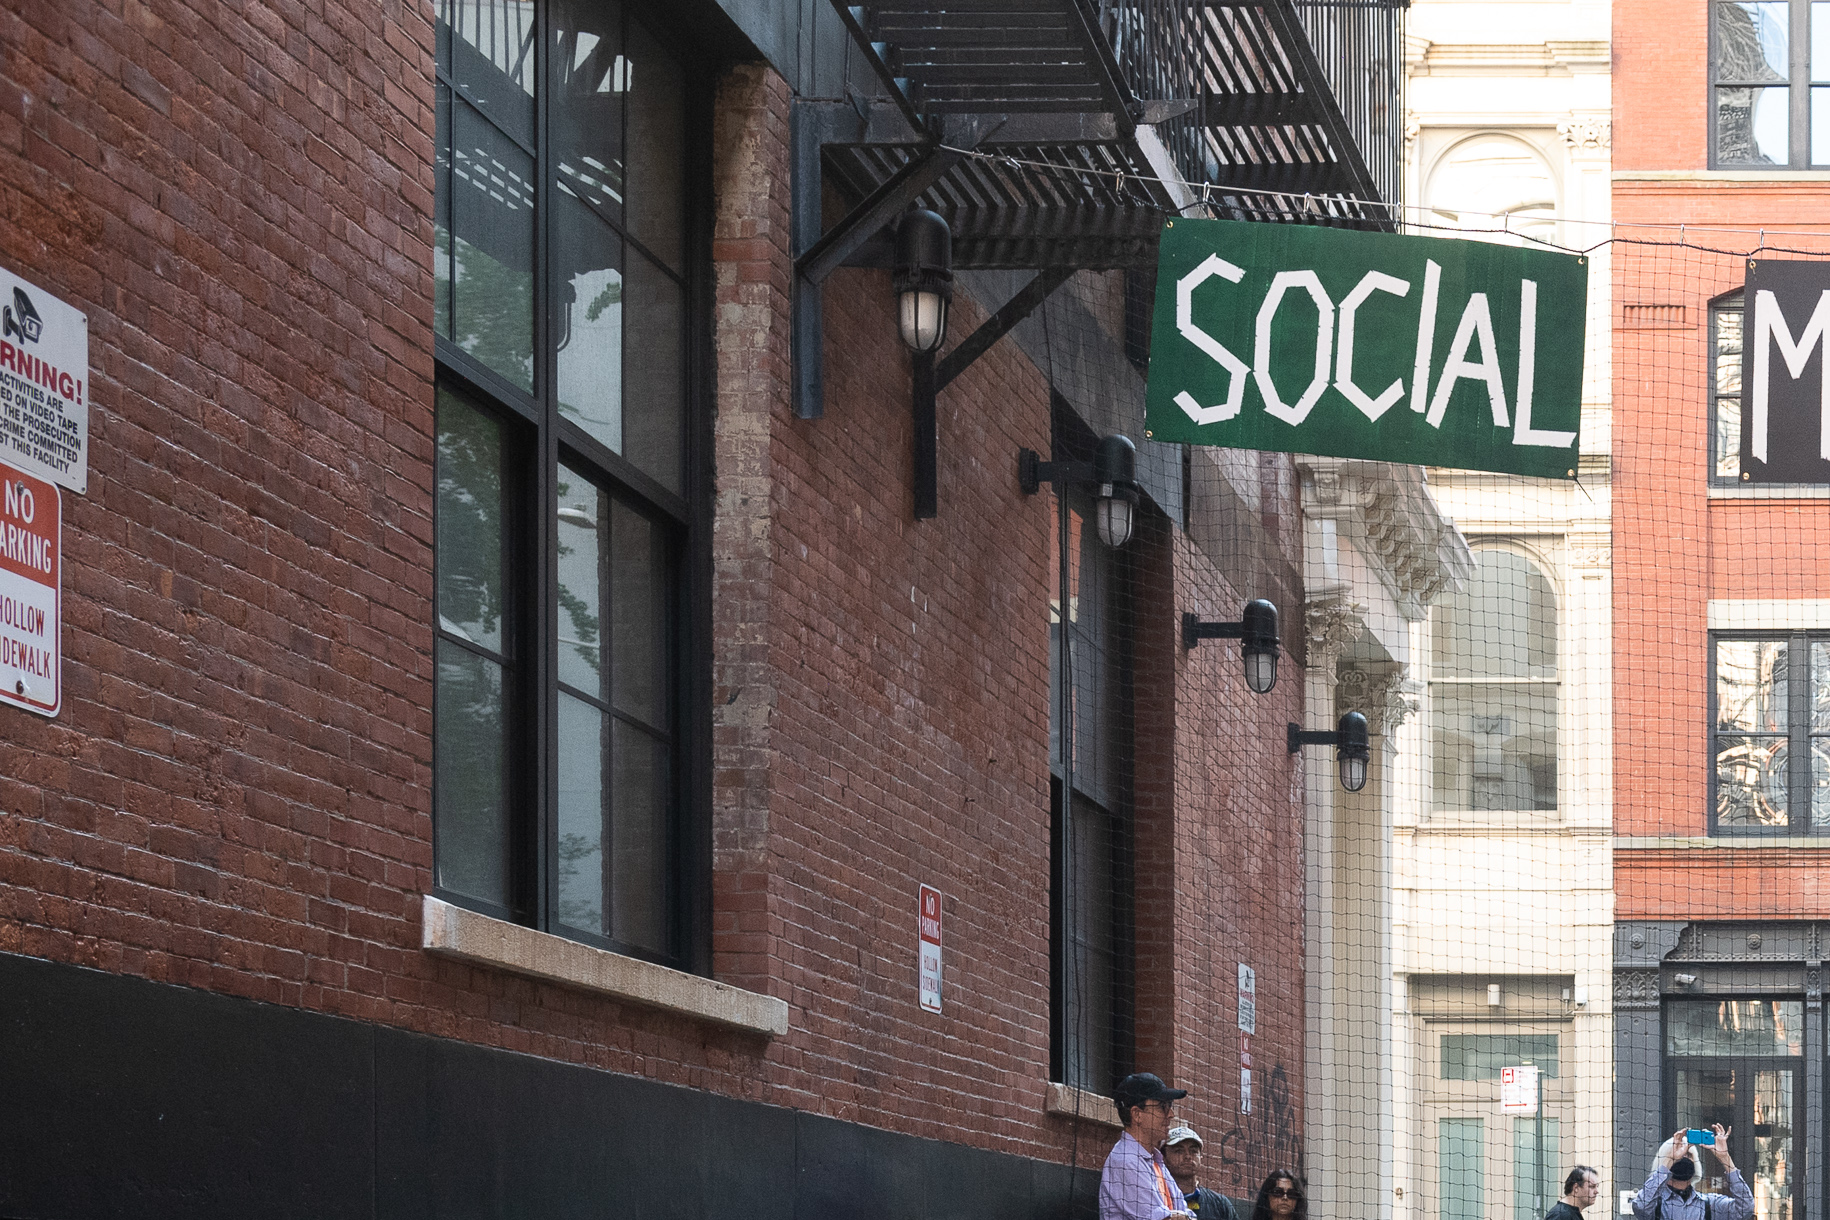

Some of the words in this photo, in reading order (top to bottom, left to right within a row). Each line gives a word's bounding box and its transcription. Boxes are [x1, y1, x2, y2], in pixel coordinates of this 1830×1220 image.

[0, 339, 82, 405] RNING!
[1173, 253, 1577, 449] SOCIAL
[0, 371, 44, 403] ACTIVITIES
[46, 395, 63, 413] ARE
[0, 387, 12, 401] ED
[15, 394, 27, 409] ON
[30, 400, 55, 423] VIDEO
[57, 413, 78, 435] TAPE
[3, 403, 20, 421] THE
[23, 412, 81, 451] PROSECUTION
[28, 430, 78, 463] COMMITTED
[12, 437, 31, 457] THIS
[33, 448, 70, 474] FACILITY
[5, 479, 35, 524] NO
[0, 520, 52, 574] ARKING
[921, 915, 940, 940] PARKING
[925, 894, 936, 916] NO
